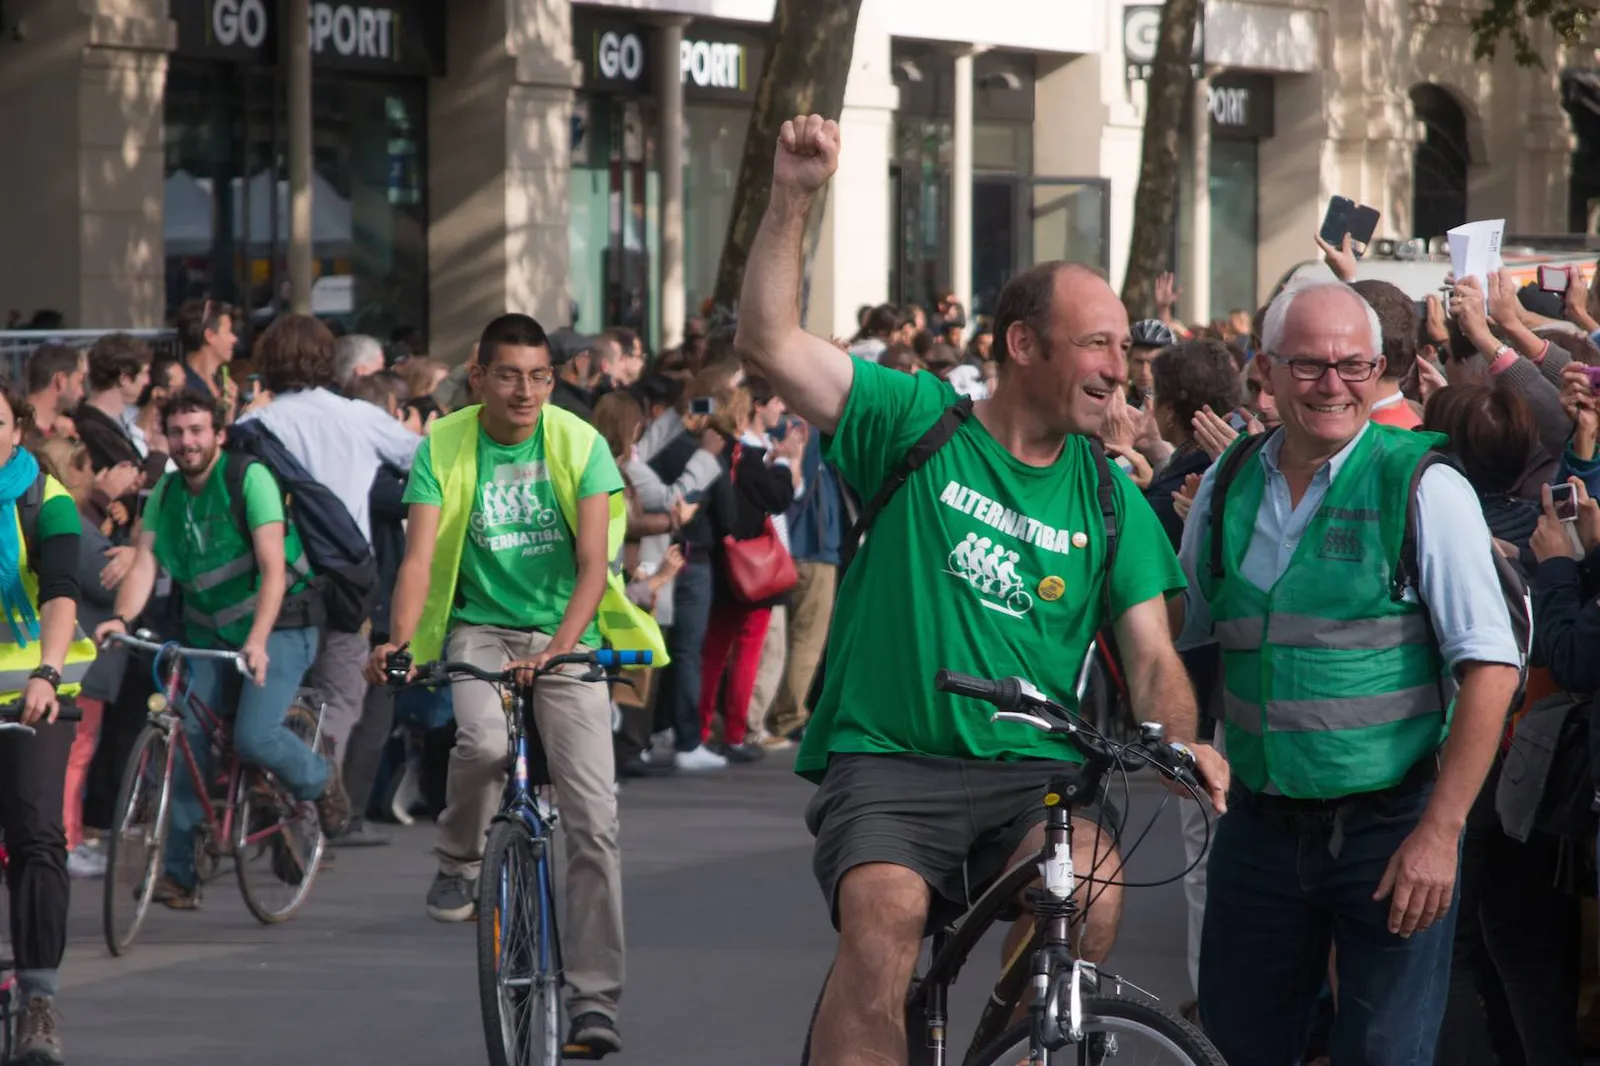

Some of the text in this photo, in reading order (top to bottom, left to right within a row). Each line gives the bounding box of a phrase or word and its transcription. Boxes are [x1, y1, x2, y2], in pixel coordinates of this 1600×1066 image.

[212, 0, 267, 47] GO
[1125, 9, 1203, 63] G
[599, 31, 643, 80] GO
[939, 480, 1070, 555] ALTERNATIBA
